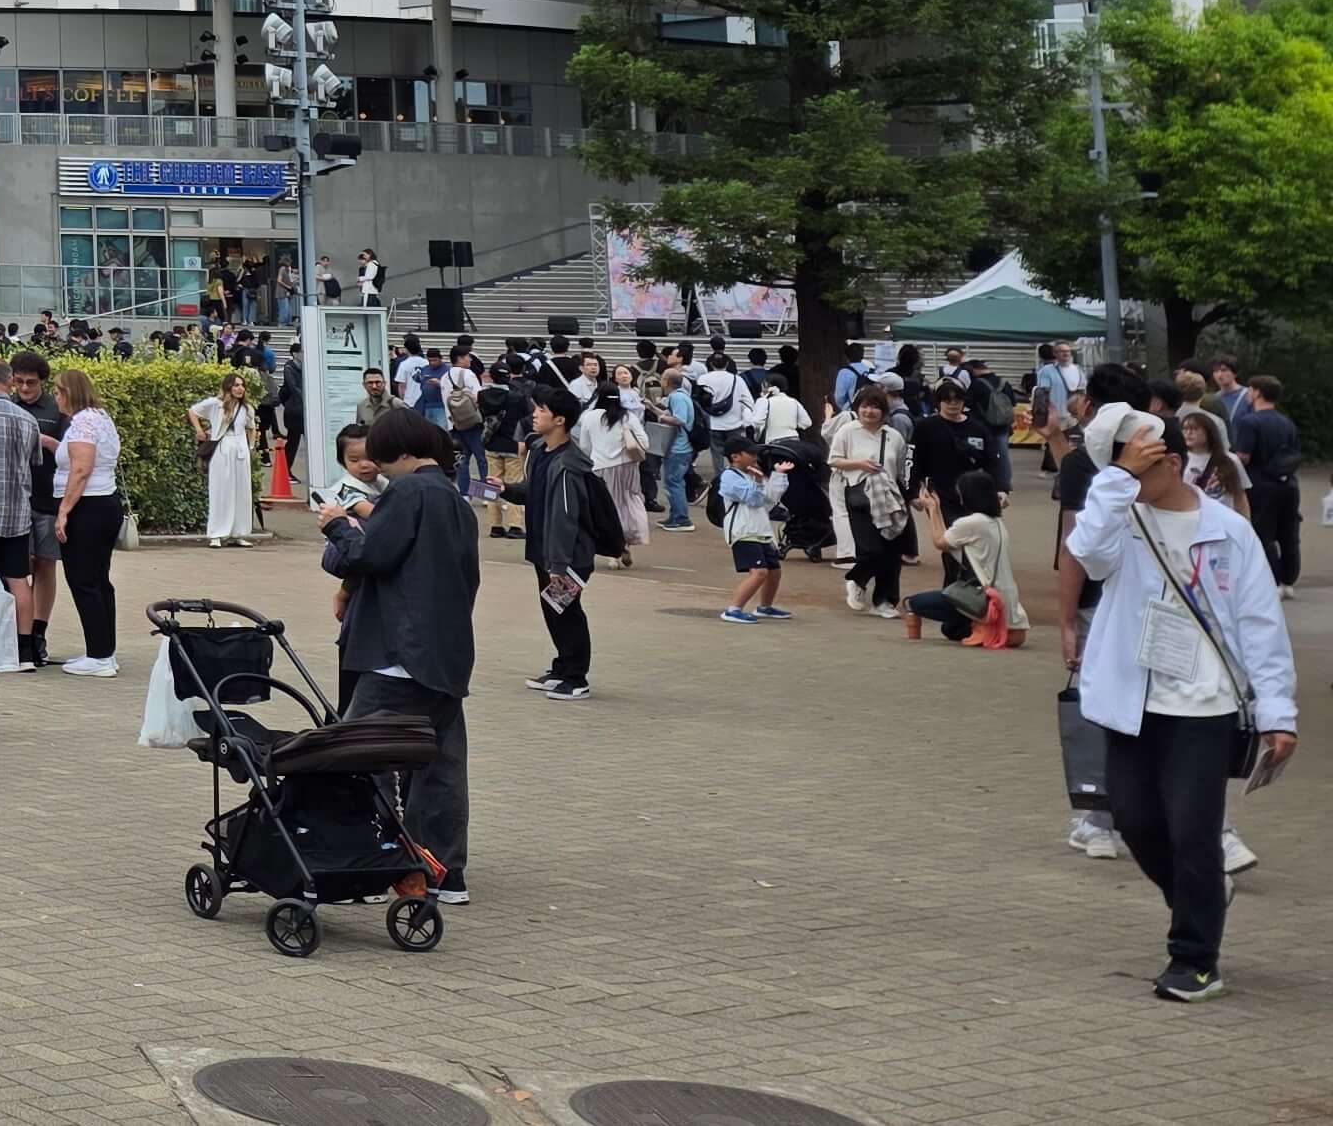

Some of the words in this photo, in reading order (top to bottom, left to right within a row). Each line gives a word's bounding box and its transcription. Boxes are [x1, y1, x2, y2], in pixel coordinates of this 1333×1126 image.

[121, 161, 153, 183] THE
[159, 162, 235, 185] GUNDAM
[241, 164, 287, 186] BASE
[179, 185, 231, 195] TOKYO
